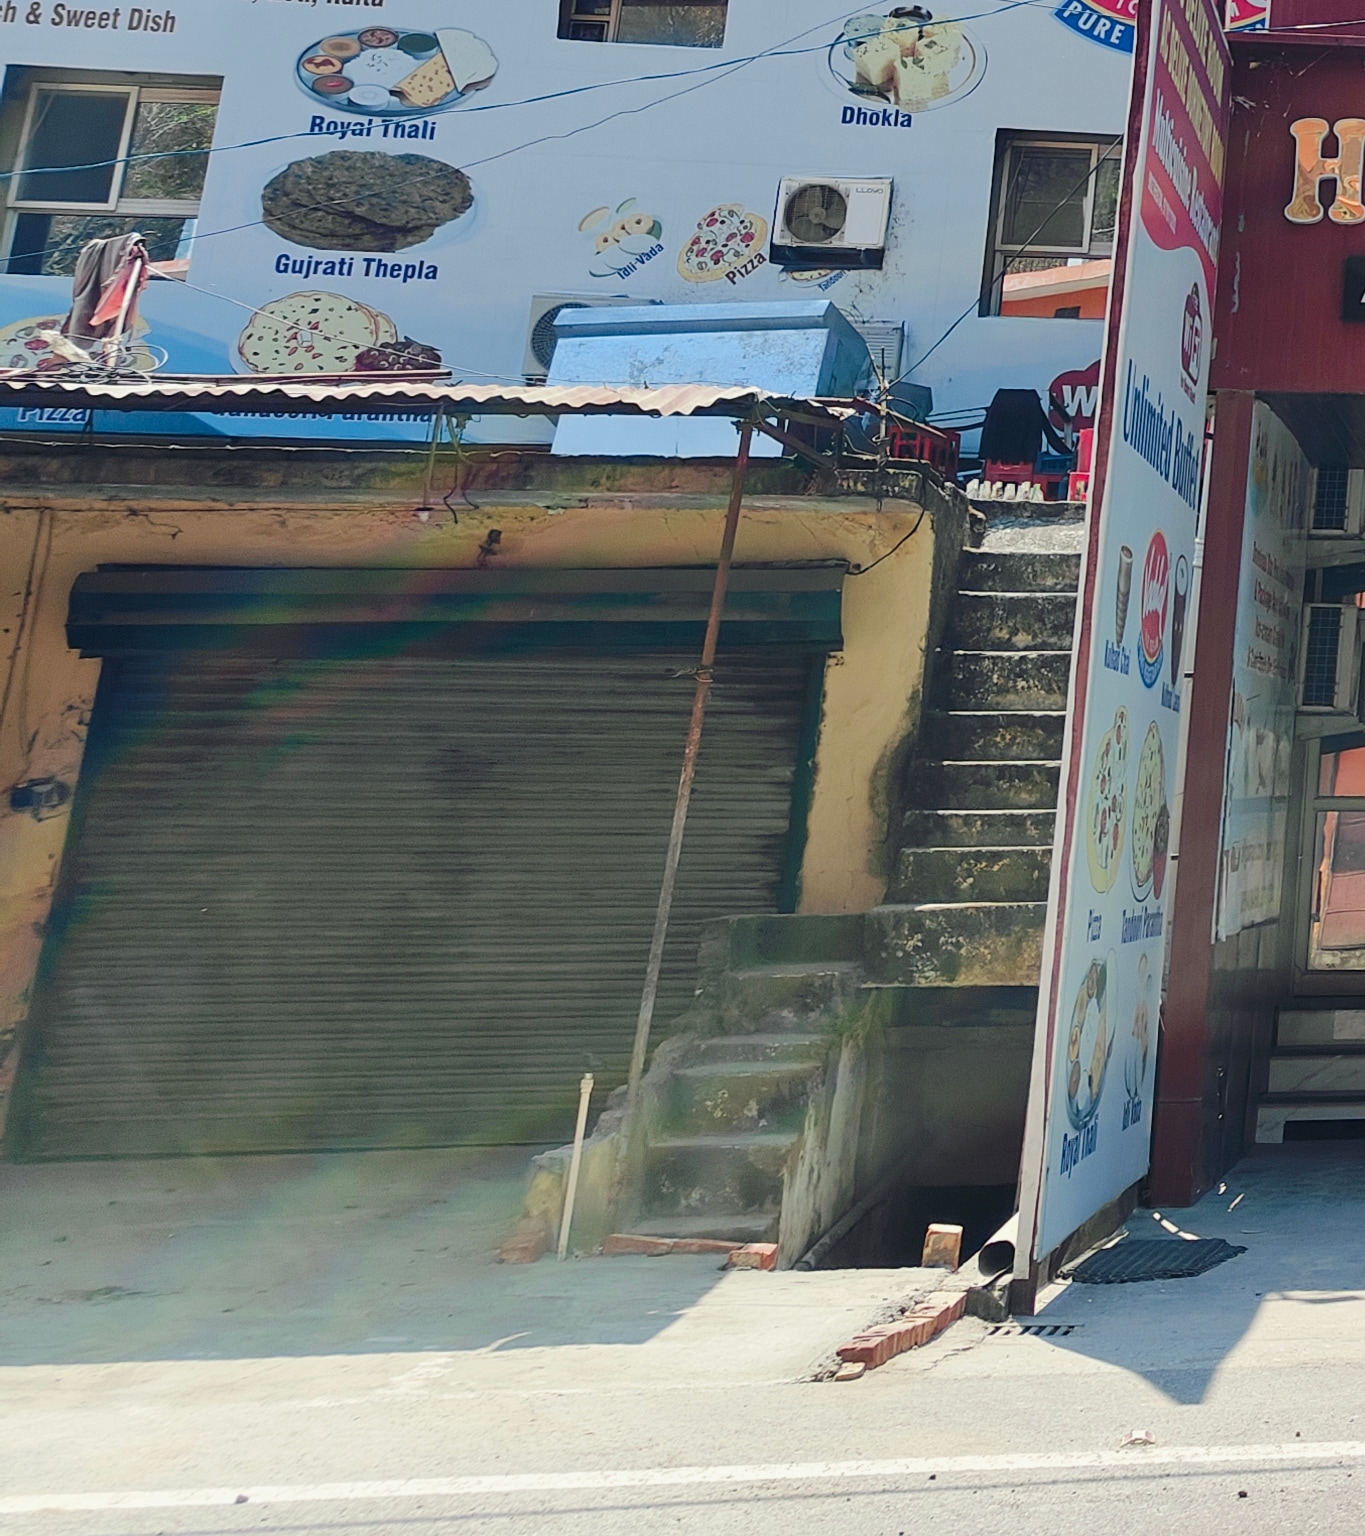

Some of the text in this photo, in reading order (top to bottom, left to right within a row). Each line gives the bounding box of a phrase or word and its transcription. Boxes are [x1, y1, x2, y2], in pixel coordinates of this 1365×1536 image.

[25, 1, 42, 25] &
[51, 3, 121, 30] Sweet
[127, 8, 176, 33] Dish
[1062, 1, 1126, 45] PURE
[310, 115, 437, 141] Royal Thali
[841, 106, 913, 128] Dhokla
[274, 252, 439, 282] Gujrati Thepla
[725, 250, 767, 285] Pizza
[1123, 358, 1175, 490] Unlimited
[1175, 416, 1199, 511] Buffet
